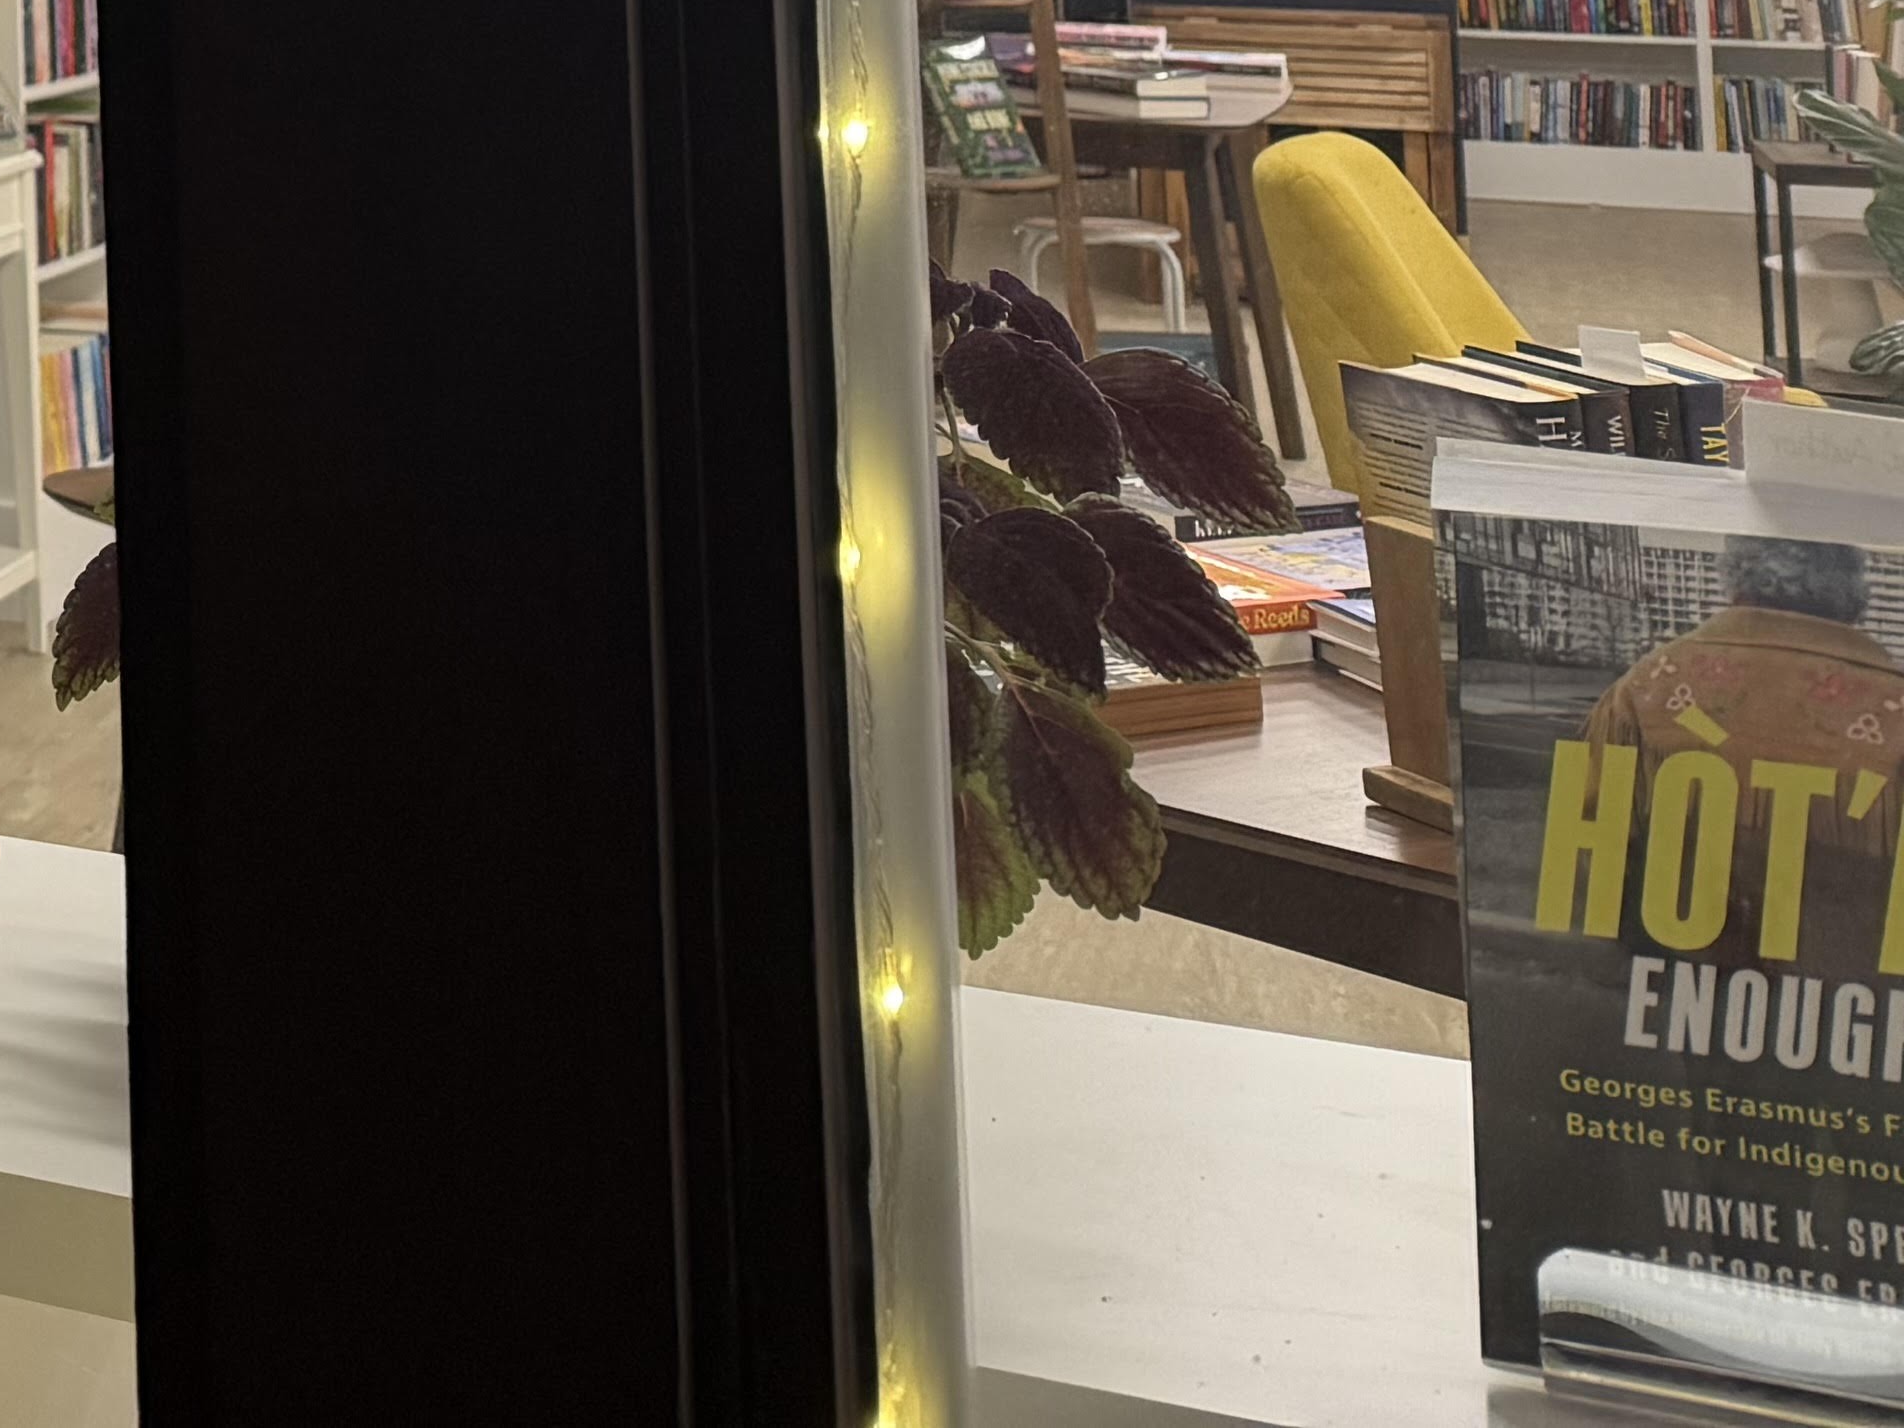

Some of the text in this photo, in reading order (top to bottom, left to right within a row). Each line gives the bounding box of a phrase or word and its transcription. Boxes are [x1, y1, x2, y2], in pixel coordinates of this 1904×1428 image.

[1653, 409, 1671, 441] The
[1254, 603, 1310, 629] Reeds
[1559, 1068, 1694, 1110] Georges
[1705, 1087, 1872, 1136] Erasmus's
[1566, 1112, 1666, 1149] Battle
[1677, 1126, 1727, 1158] for
[1662, 1188, 1780, 1244] WAYNE
[1796, 1206, 1830, 1253] K.
